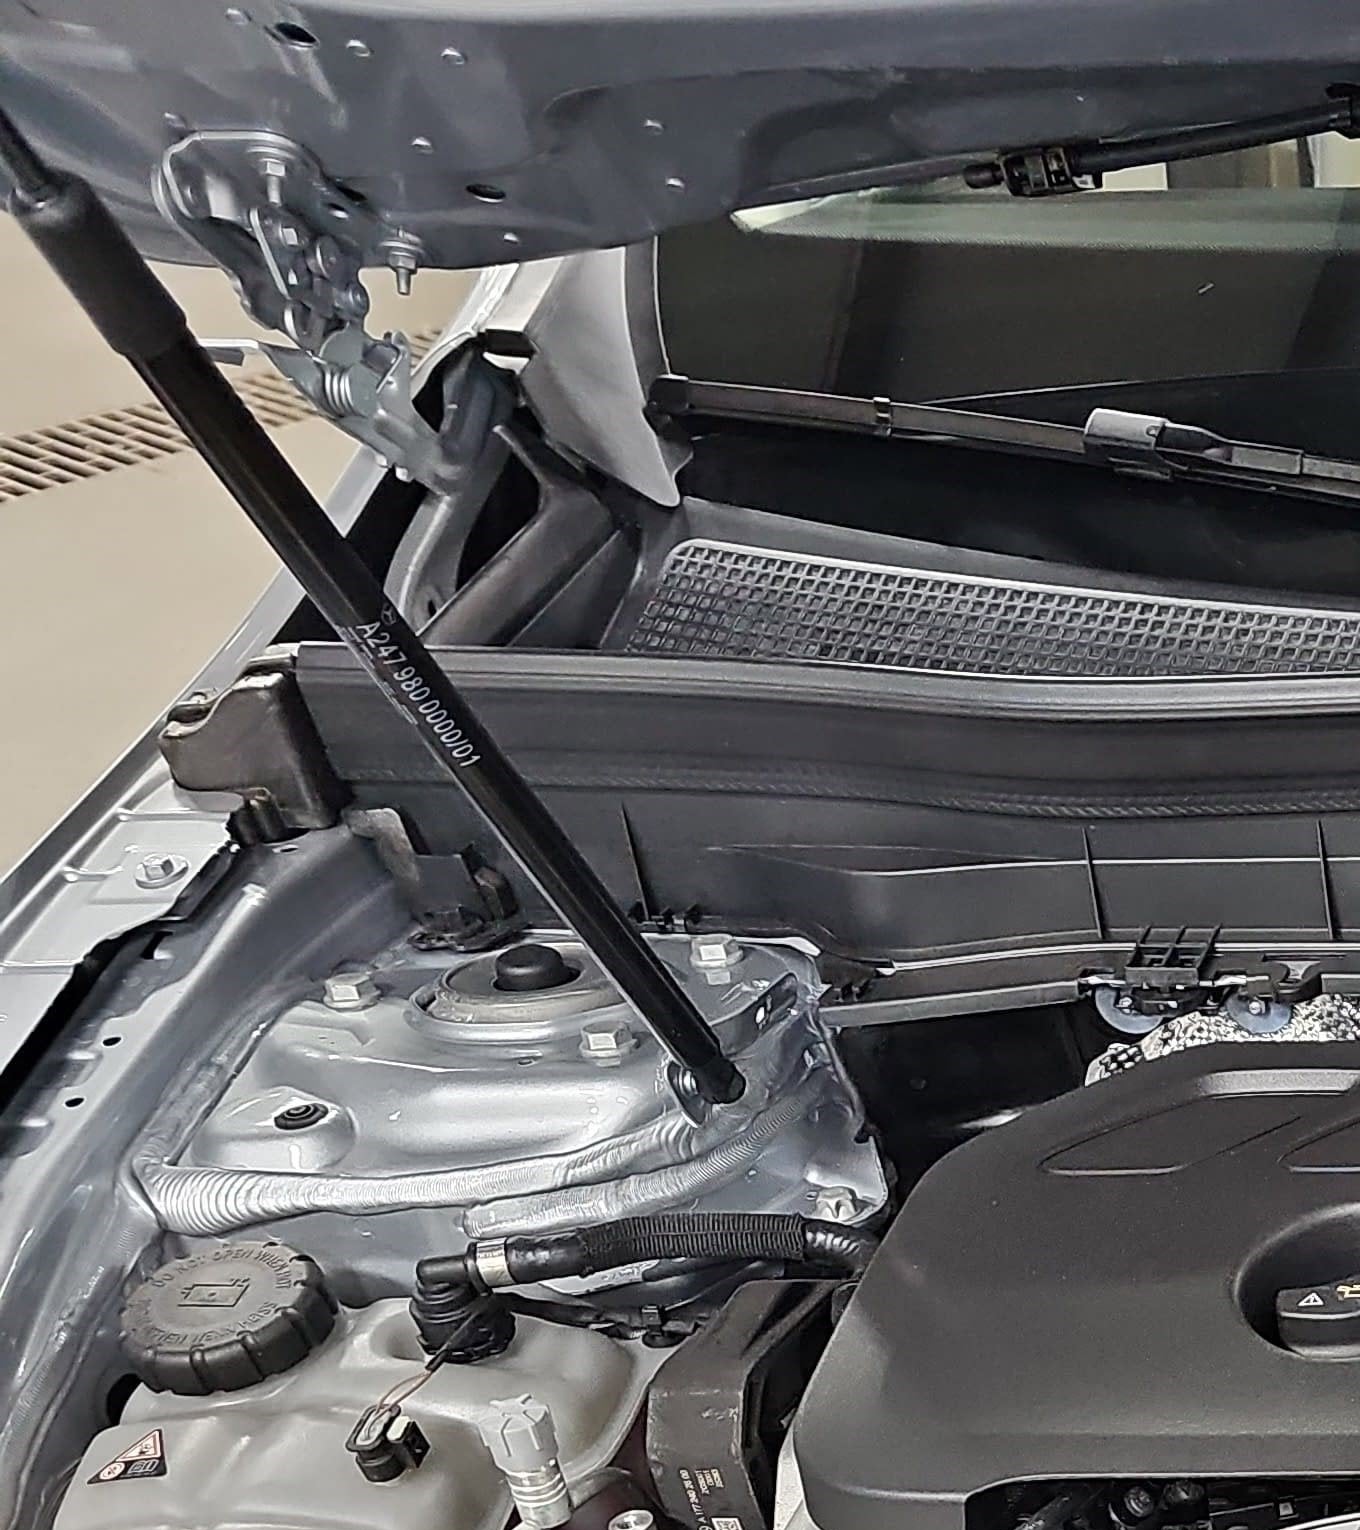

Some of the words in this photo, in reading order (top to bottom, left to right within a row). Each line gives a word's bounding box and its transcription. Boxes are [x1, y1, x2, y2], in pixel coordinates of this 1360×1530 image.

[355, 621, 408, 665] A247
[393, 666, 431, 702] 980
[418, 699, 481, 767] 0000/01
[212, 1248, 254, 1262] OPEN
